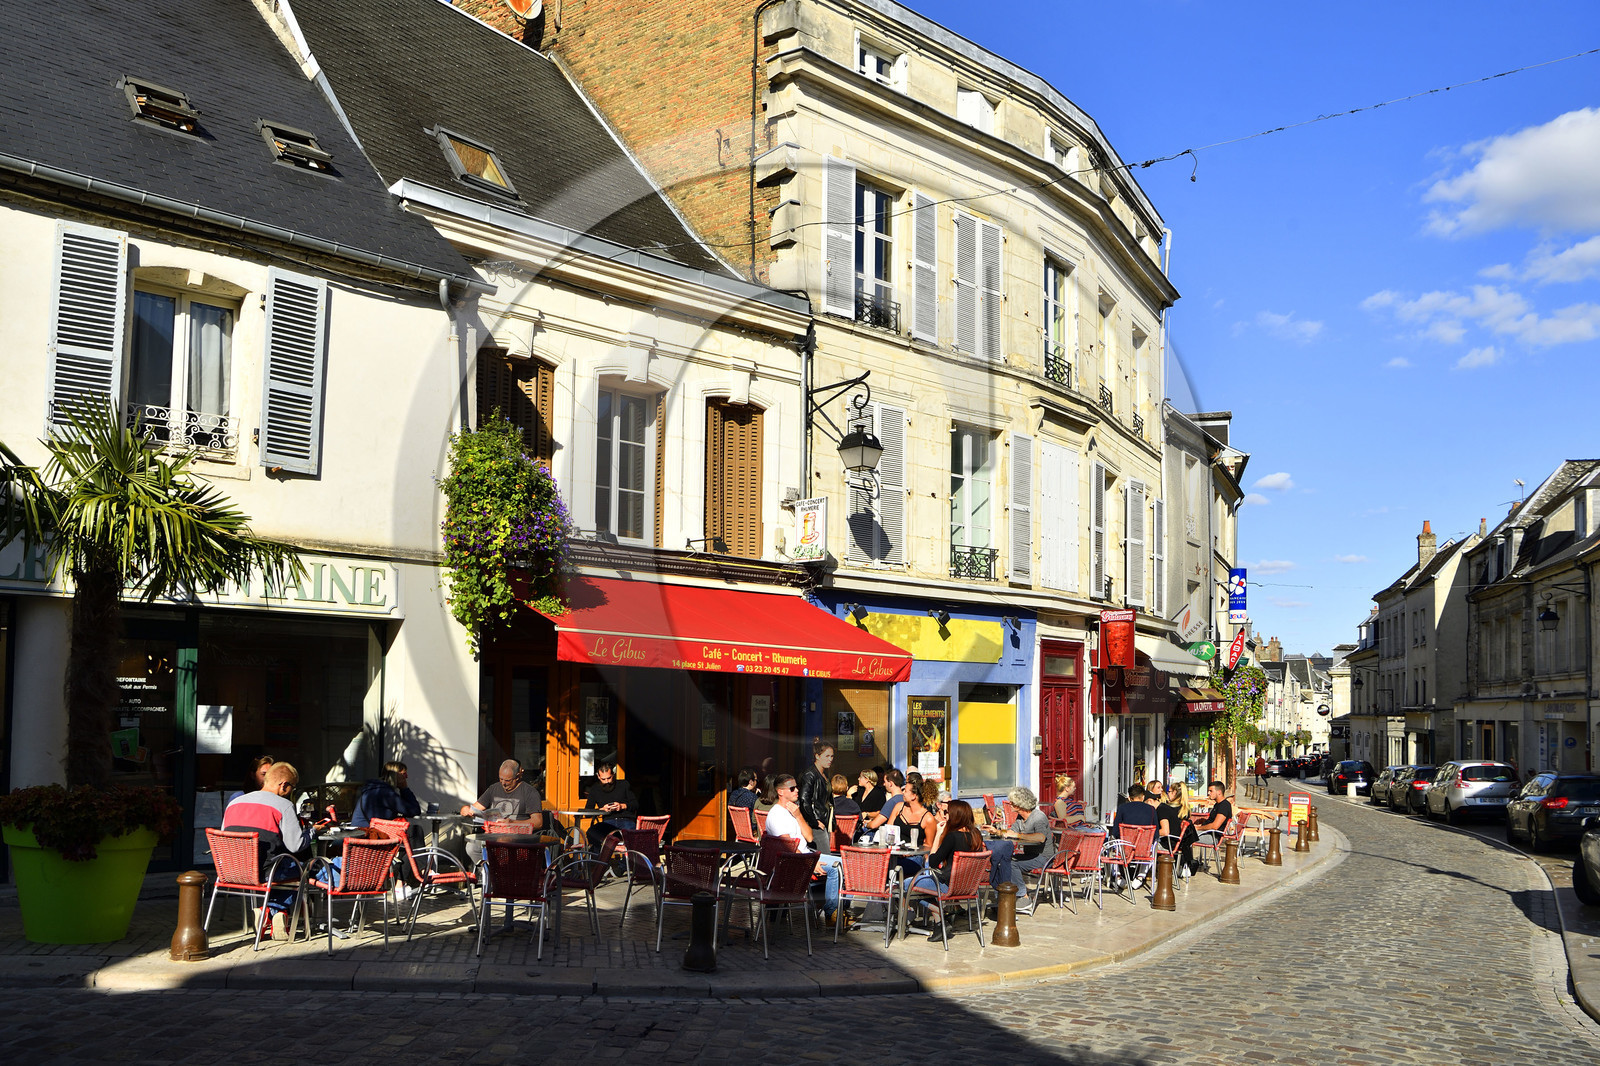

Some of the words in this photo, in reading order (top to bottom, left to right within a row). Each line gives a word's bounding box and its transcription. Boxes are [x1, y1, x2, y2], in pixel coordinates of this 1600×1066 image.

[1184, 621, 1204, 638] PRESSE
[588, 636, 607, 657] Le
[611, 638, 646, 663] Gibus
[703, 646, 722, 659] Café
[732, 648, 762, 662] Concert
[772, 653, 807, 665] Rhumerie
[1230, 634, 1243, 663] TABAC
[682, 661, 696, 669] place
[705, 662, 722, 670] Julien
[816, 670, 831, 678] GIBUS
[852, 657, 866, 674] Le
[868, 658, 894, 679] Gibus
[912, 702, 922, 710] LES
